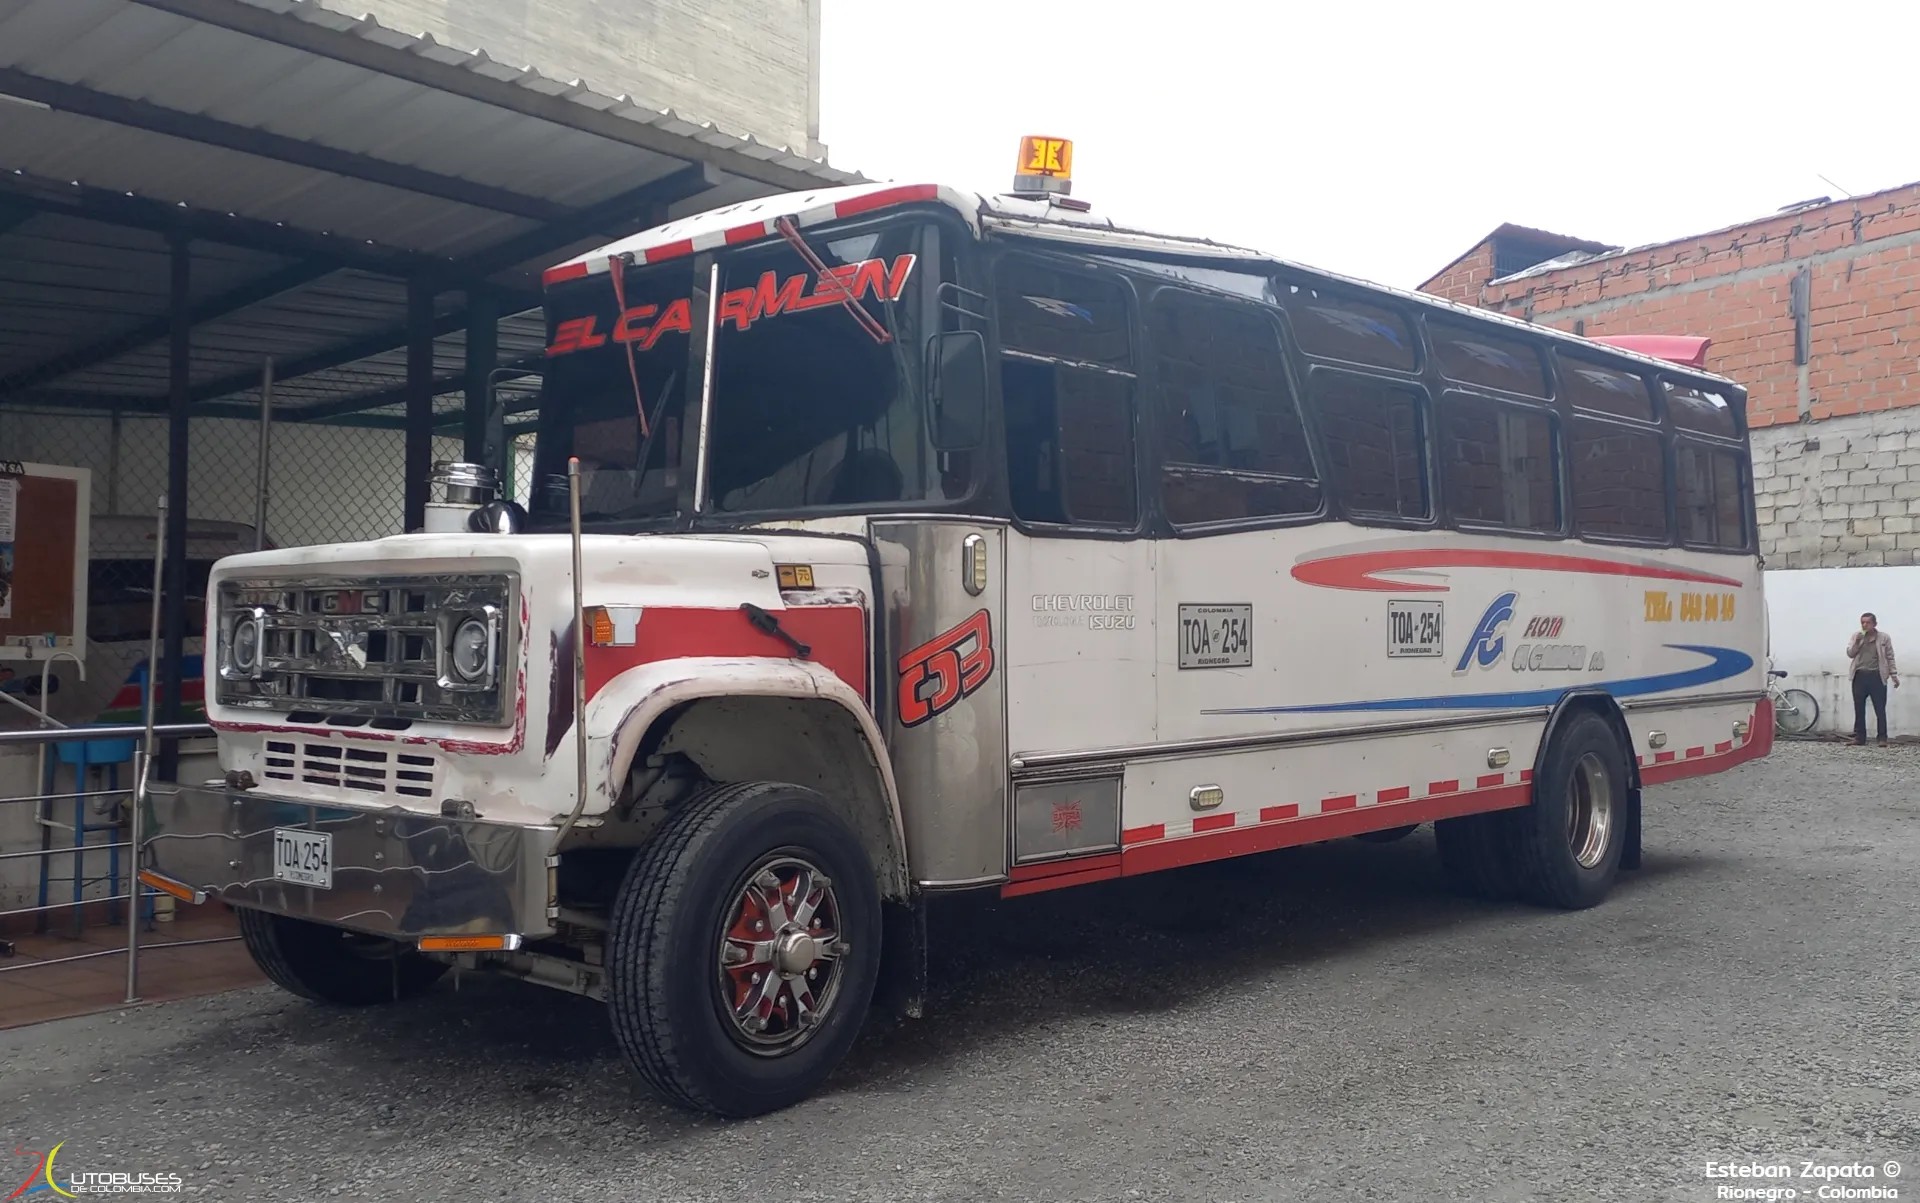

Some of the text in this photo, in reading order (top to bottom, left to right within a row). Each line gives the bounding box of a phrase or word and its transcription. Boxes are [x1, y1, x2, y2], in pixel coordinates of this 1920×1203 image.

[545, 253, 916, 357] EL CARMEN
[322, 590, 379, 614] GMC
[1031, 594, 1134, 612] CHEVROLET
[1088, 615, 1136, 630] ISUZU
[1522, 616, 1566, 639] FLOTA
[1183, 618, 1248, 655] TOA 254
[276, 837, 329, 873] TOA 254
